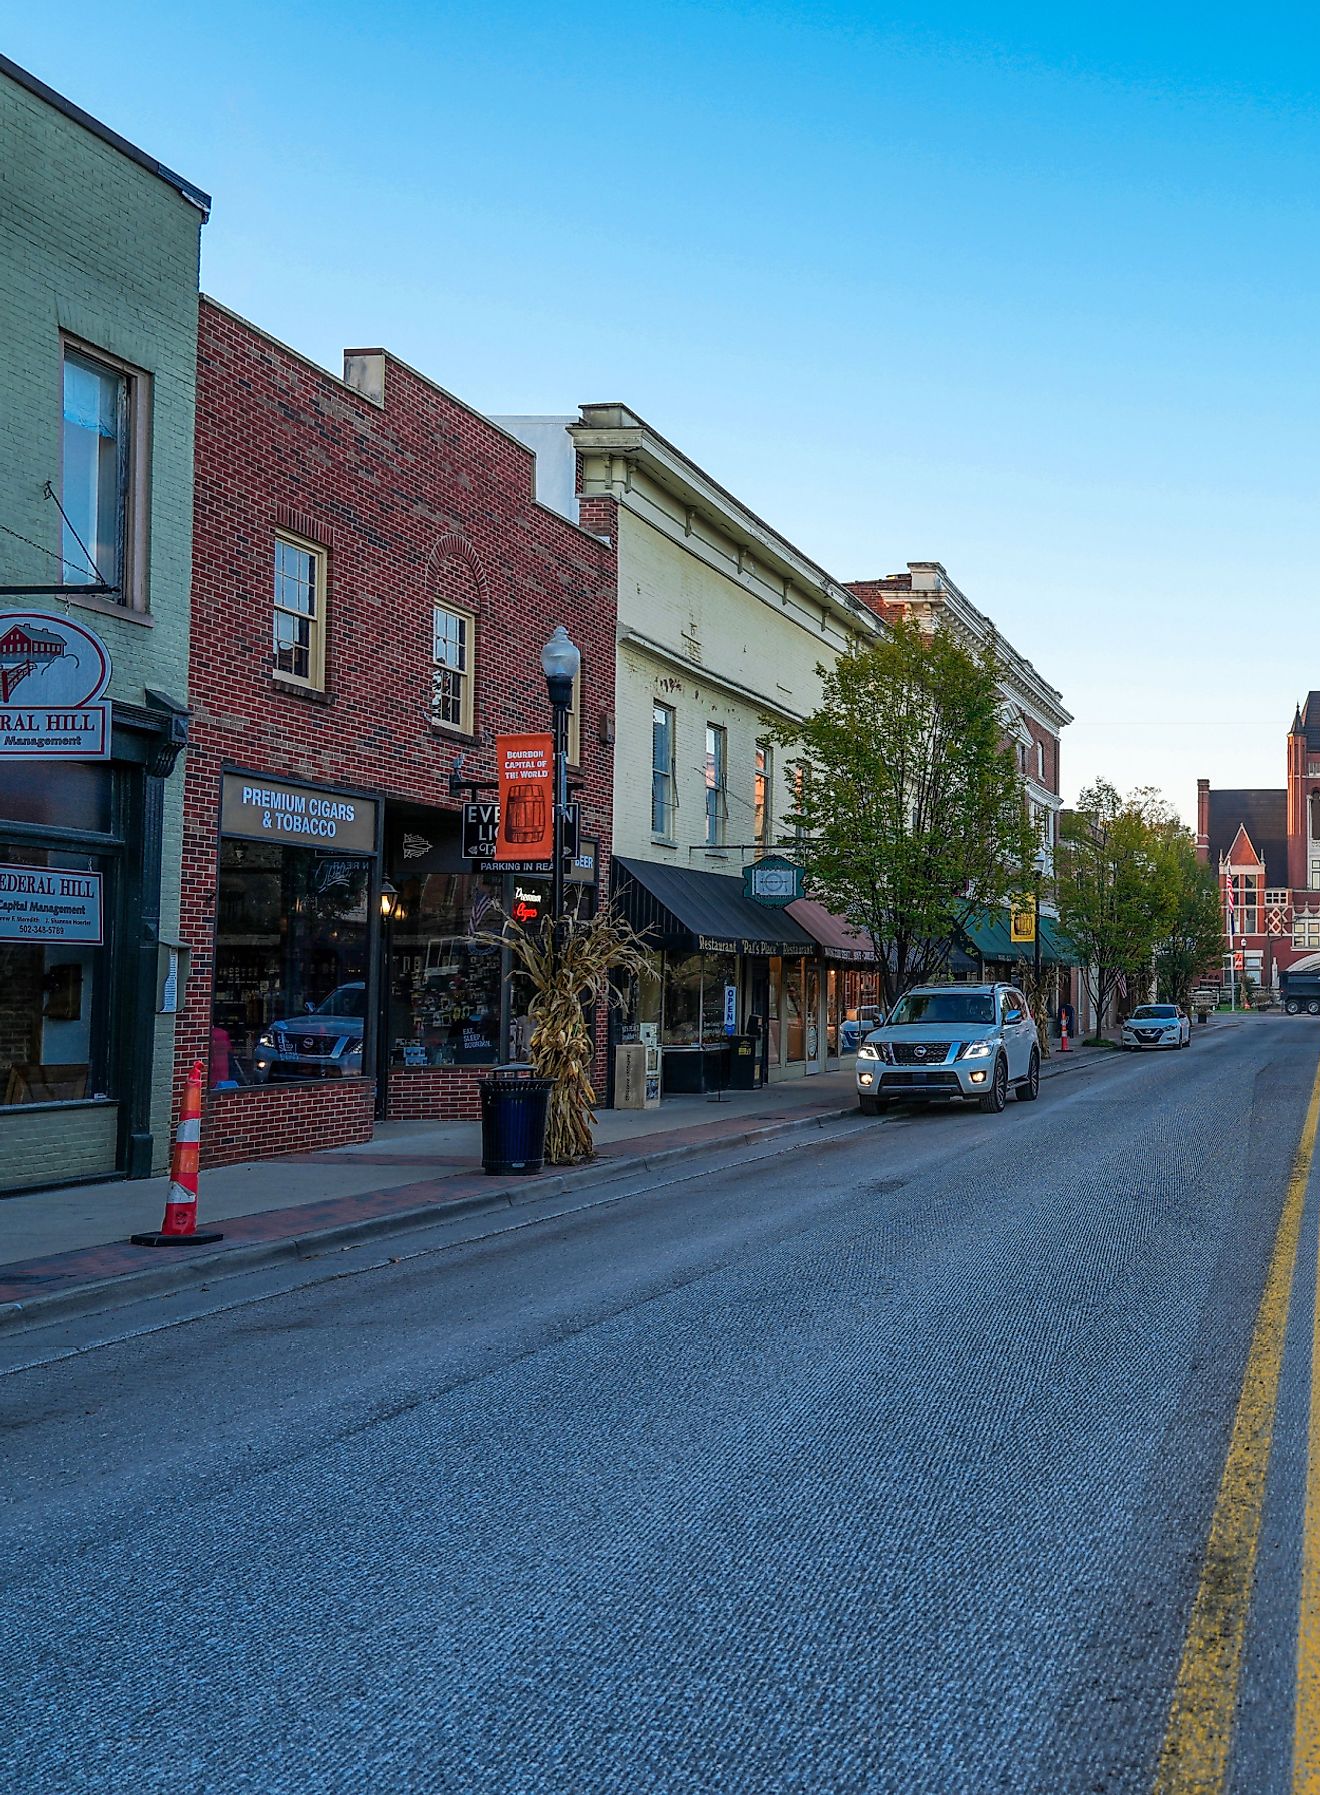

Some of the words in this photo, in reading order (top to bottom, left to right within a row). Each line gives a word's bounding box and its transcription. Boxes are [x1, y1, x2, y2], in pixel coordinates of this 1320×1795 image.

[46, 714, 95, 731] HILL
[4, 736, 82, 747] Management
[507, 751, 544, 759] BOURBON
[505, 761, 536, 769] CAPITAL
[537, 760, 547, 768] OF
[505, 771, 519, 779] THE
[520, 770, 548, 779] WORLD
[242, 786, 306, 813] PREMIUM
[308, 799, 355, 822] CIGARS
[262, 810, 273, 829] &
[275, 812, 337, 838] TOBACCO
[480, 862, 521, 871] PARKING
[523, 862, 534, 871] IN
[536, 863, 554, 871] REA
[60, 878, 95, 899] HILL
[30, 901, 86, 916] Management
[699, 935, 737, 953] Restaurant
[783, 943, 814, 955] Restaurant
